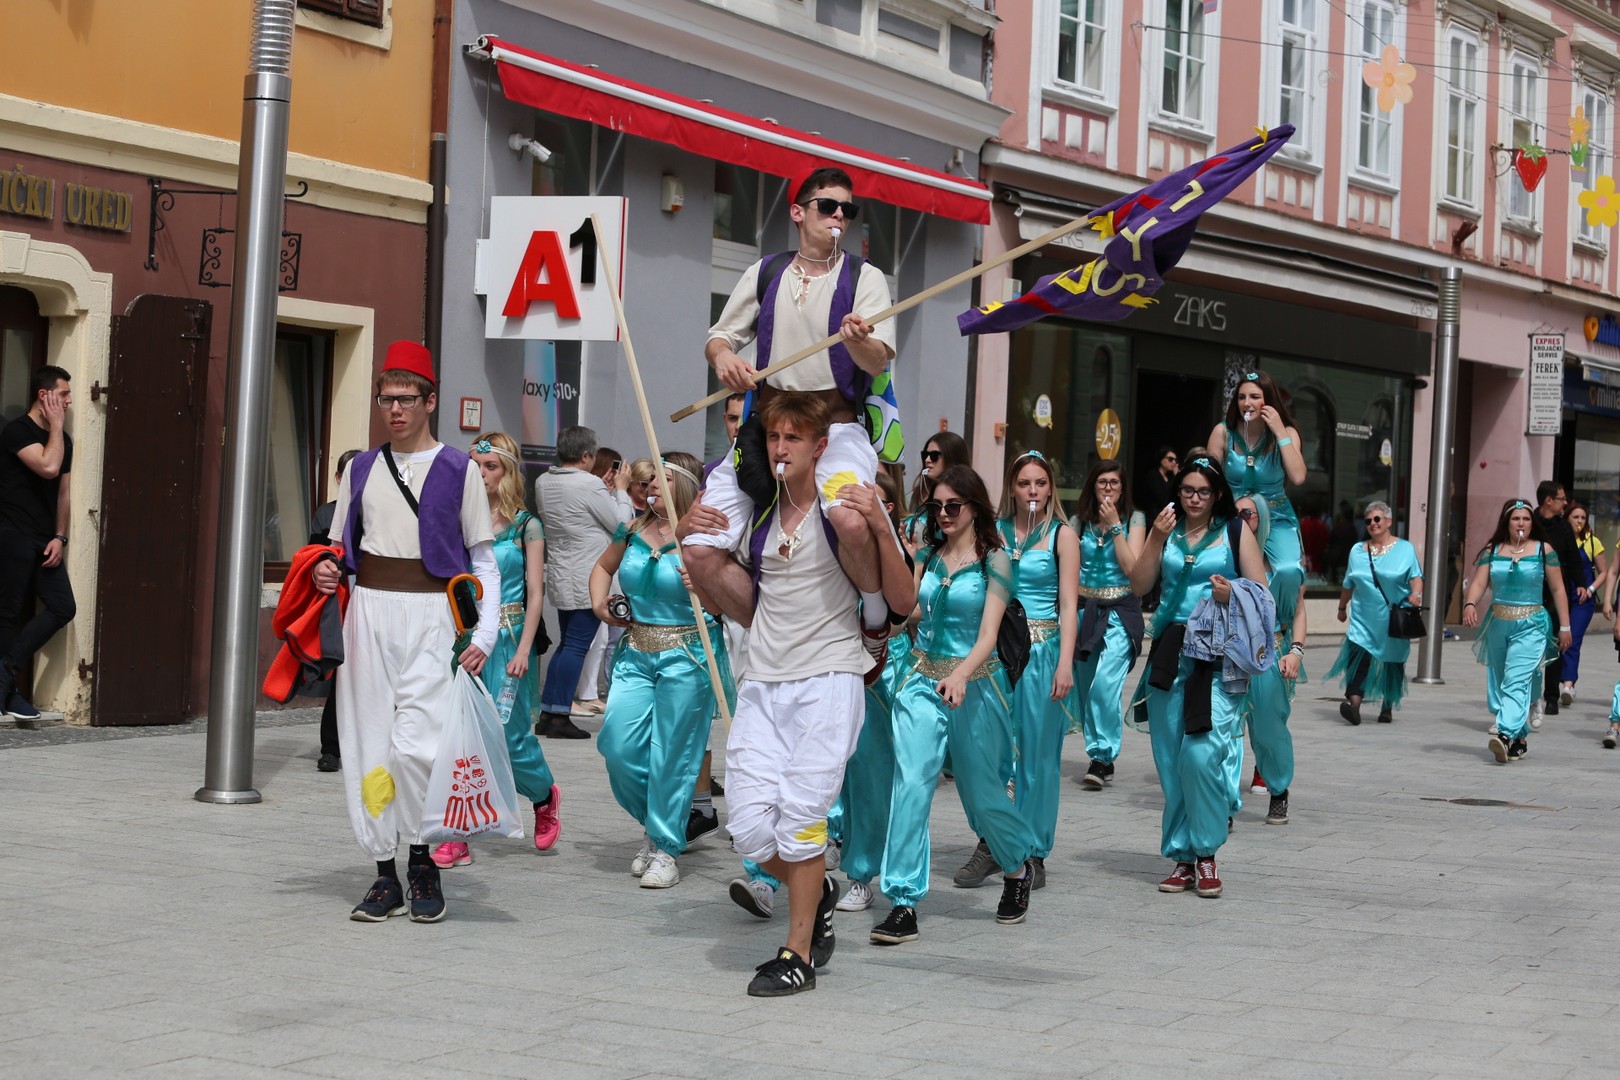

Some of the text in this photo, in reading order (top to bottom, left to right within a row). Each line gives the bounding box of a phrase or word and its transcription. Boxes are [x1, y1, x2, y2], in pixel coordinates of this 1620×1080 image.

[67, 182, 131, 230] URED
[502, 217, 598, 319] A1
[1174, 293, 1226, 331] ZAKS
[553, 382, 578, 400] S10+
